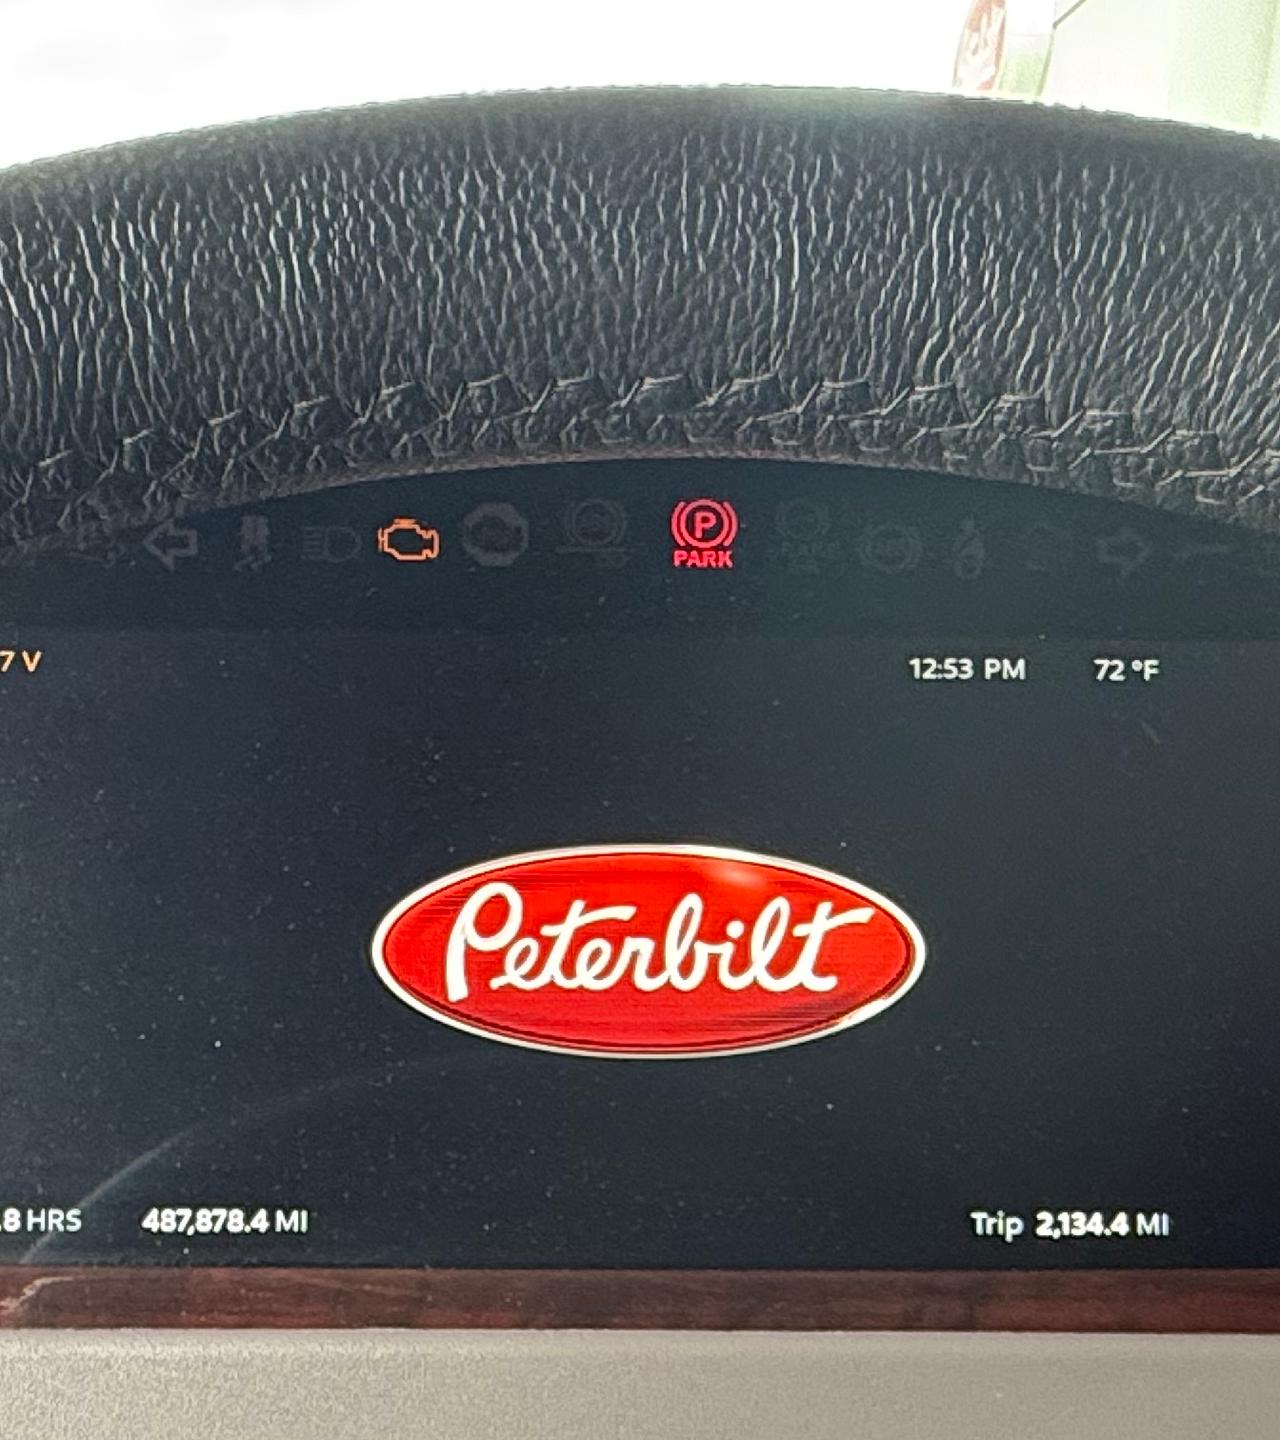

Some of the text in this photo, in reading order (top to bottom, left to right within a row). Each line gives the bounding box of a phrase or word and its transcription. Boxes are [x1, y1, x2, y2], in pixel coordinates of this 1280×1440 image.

[694, 511, 717, 539] P
[673, 549, 733, 568] PARK
[21, 649, 43, 673] V
[908, 657, 1027, 681] 12:53 PM
[1093, 658, 1161, 682] 72 °F
[444, 881, 876, 1003] Peterbilt
[26, 1207, 82, 1233] HRS
[141, 1207, 309, 1237] 487,878.4 MI
[970, 1209, 1170, 1244] Trip 2,134.4 MI
